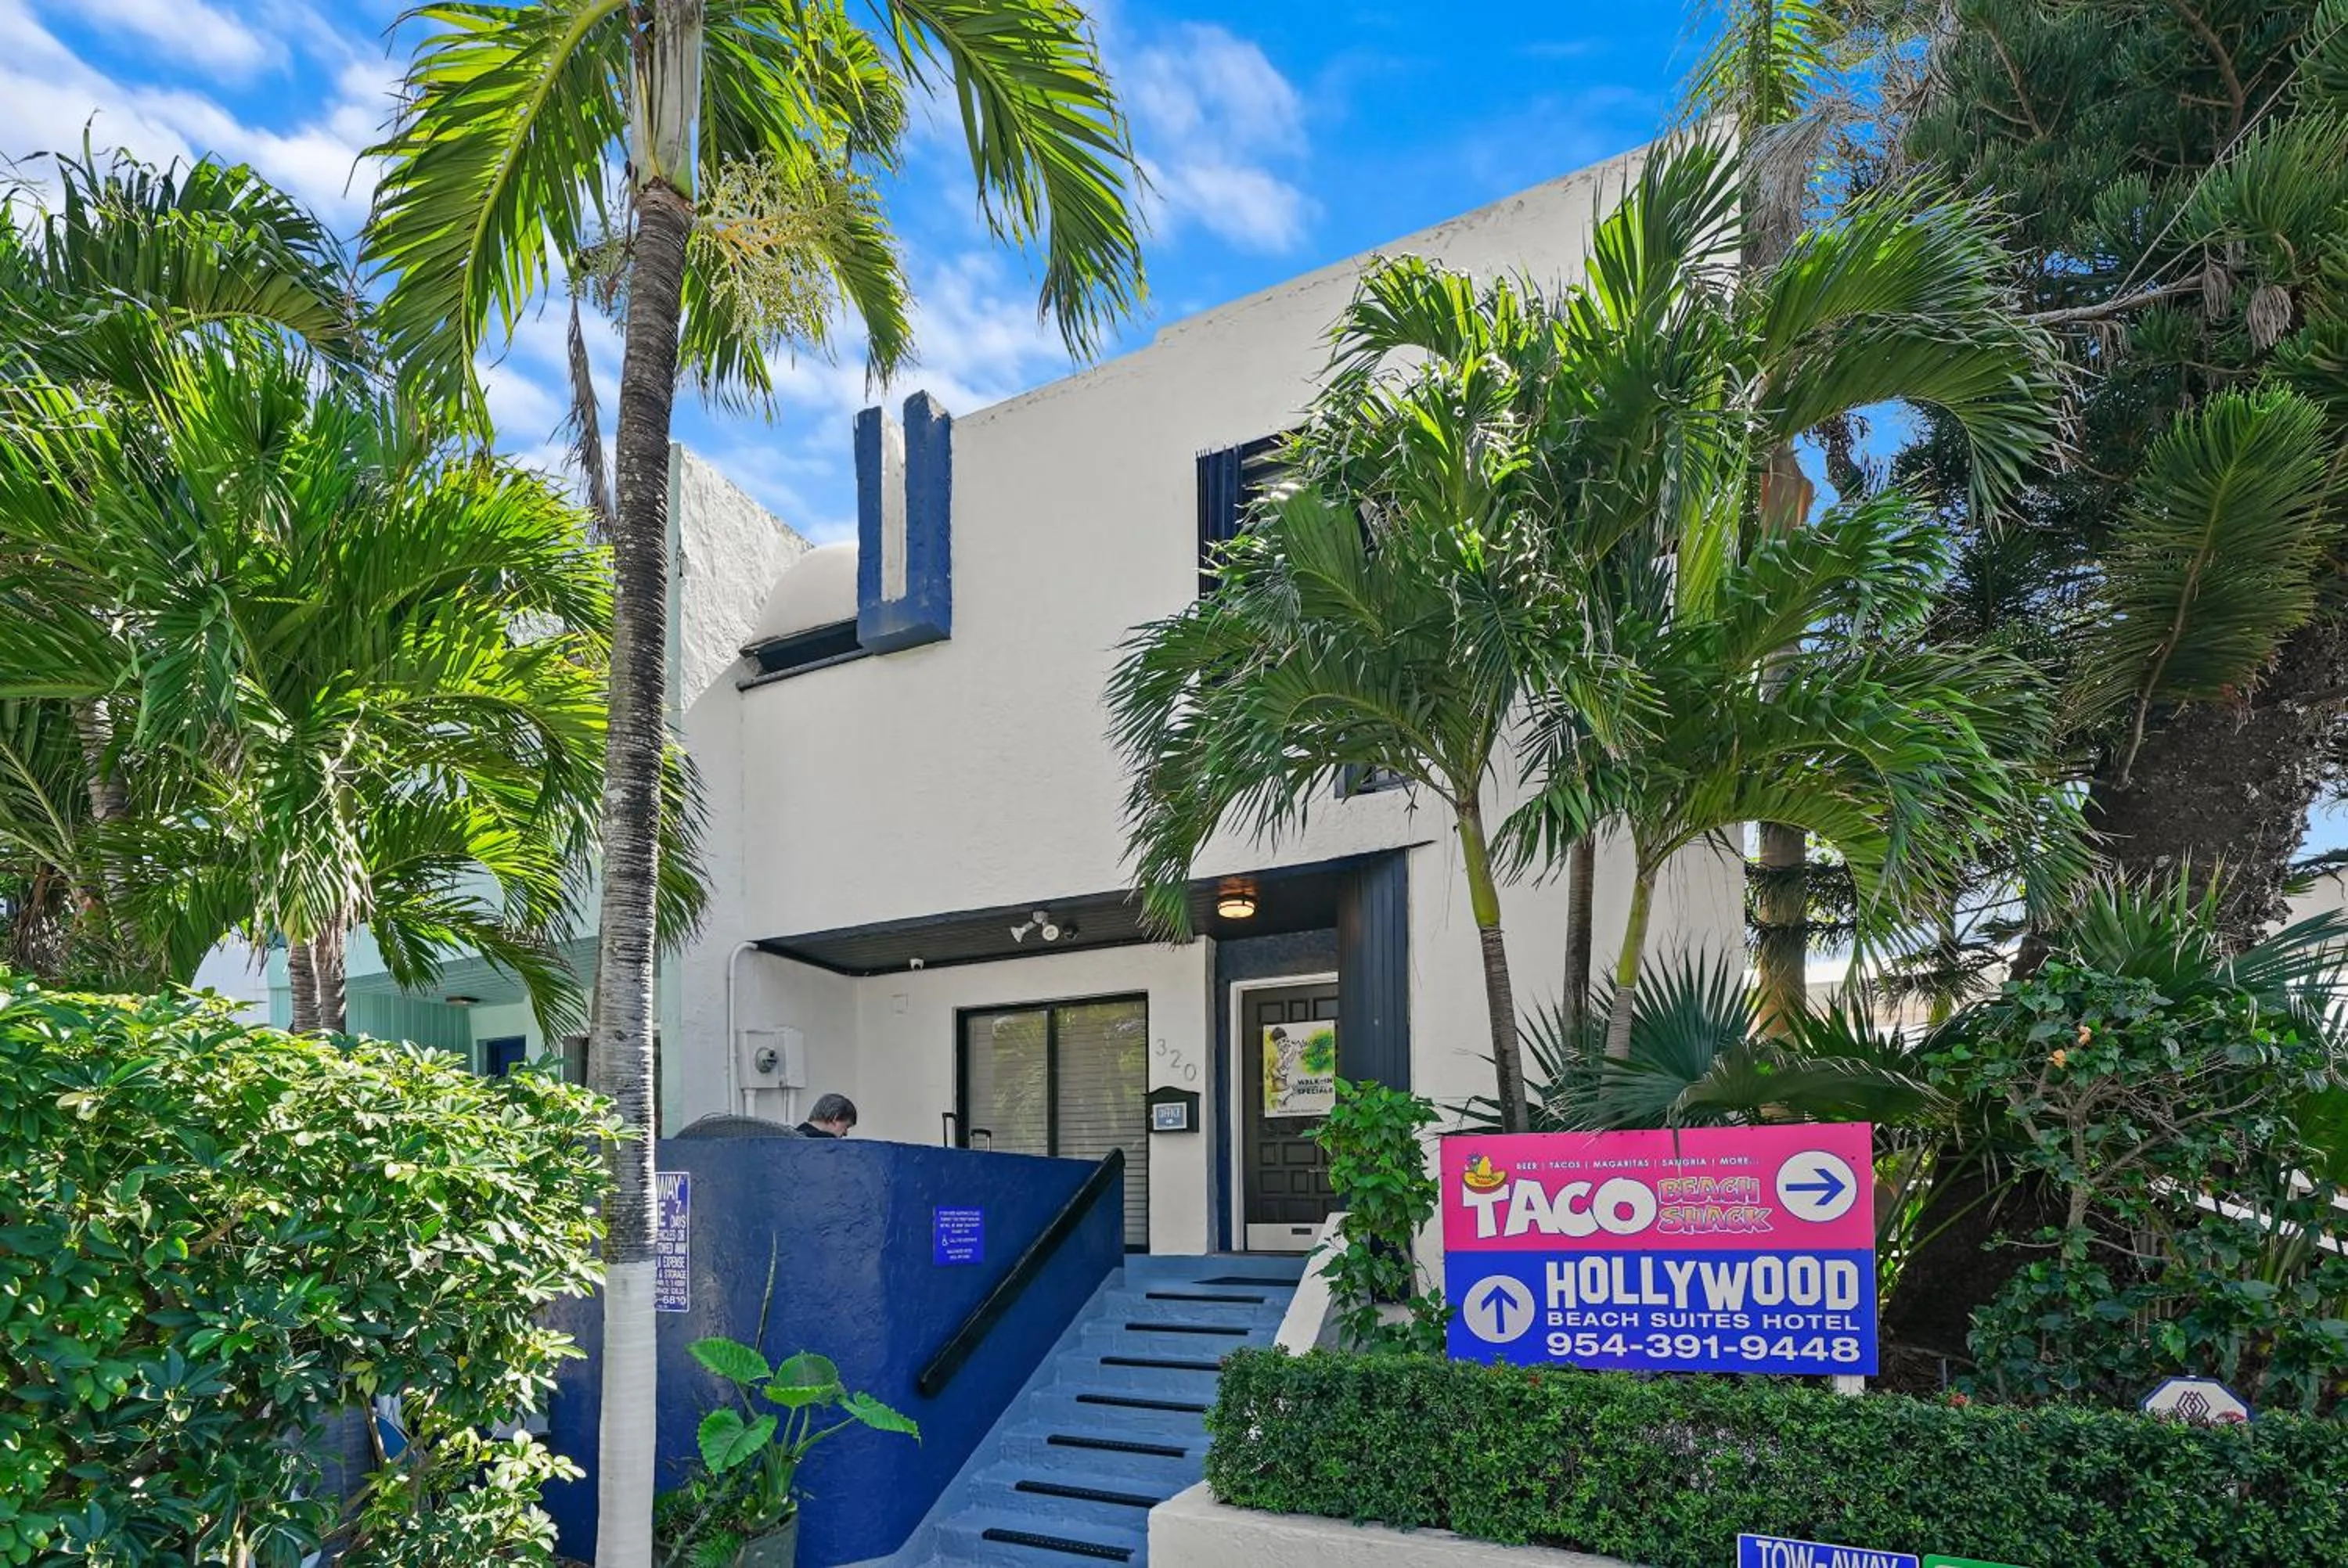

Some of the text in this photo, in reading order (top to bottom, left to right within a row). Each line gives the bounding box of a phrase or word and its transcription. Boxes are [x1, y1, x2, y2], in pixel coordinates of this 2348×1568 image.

[1156, 1038, 1196, 1081] 320
[1593, 1159, 1649, 1168] MAGARITAS
[1662, 1158, 1706, 1167] SANGRIA
[657, 1175, 681, 1199] WAY
[1657, 1177, 1760, 1205] BEACH
[1462, 1177, 1657, 1238] TACO
[1657, 1205, 1774, 1235] SHACK
[1546, 1255, 1860, 1311] HOLLYWOOD
[1547, 1312, 1861, 1331] BEACH SUITES HOTEL
[1545, 1332, 1861, 1363] 954-391-9448
